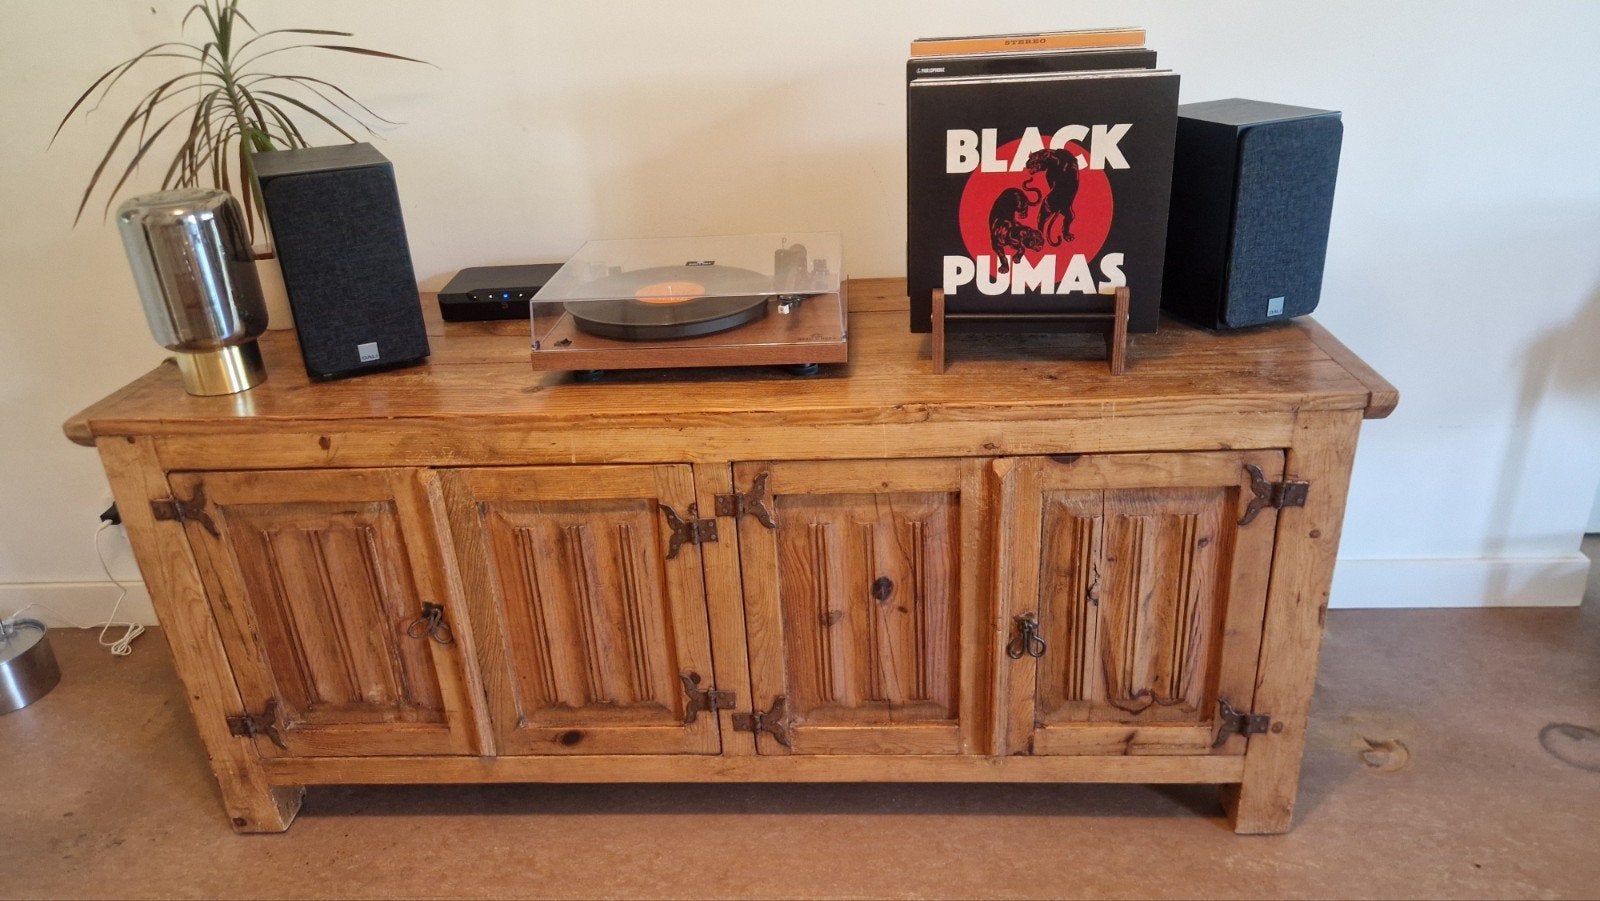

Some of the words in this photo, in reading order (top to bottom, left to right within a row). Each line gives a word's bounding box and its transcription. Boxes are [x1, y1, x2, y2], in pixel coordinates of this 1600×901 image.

[1004, 38, 1046, 46] STEREO
[946, 123, 1133, 174] BLACK
[943, 252, 1127, 296] PUMAS
